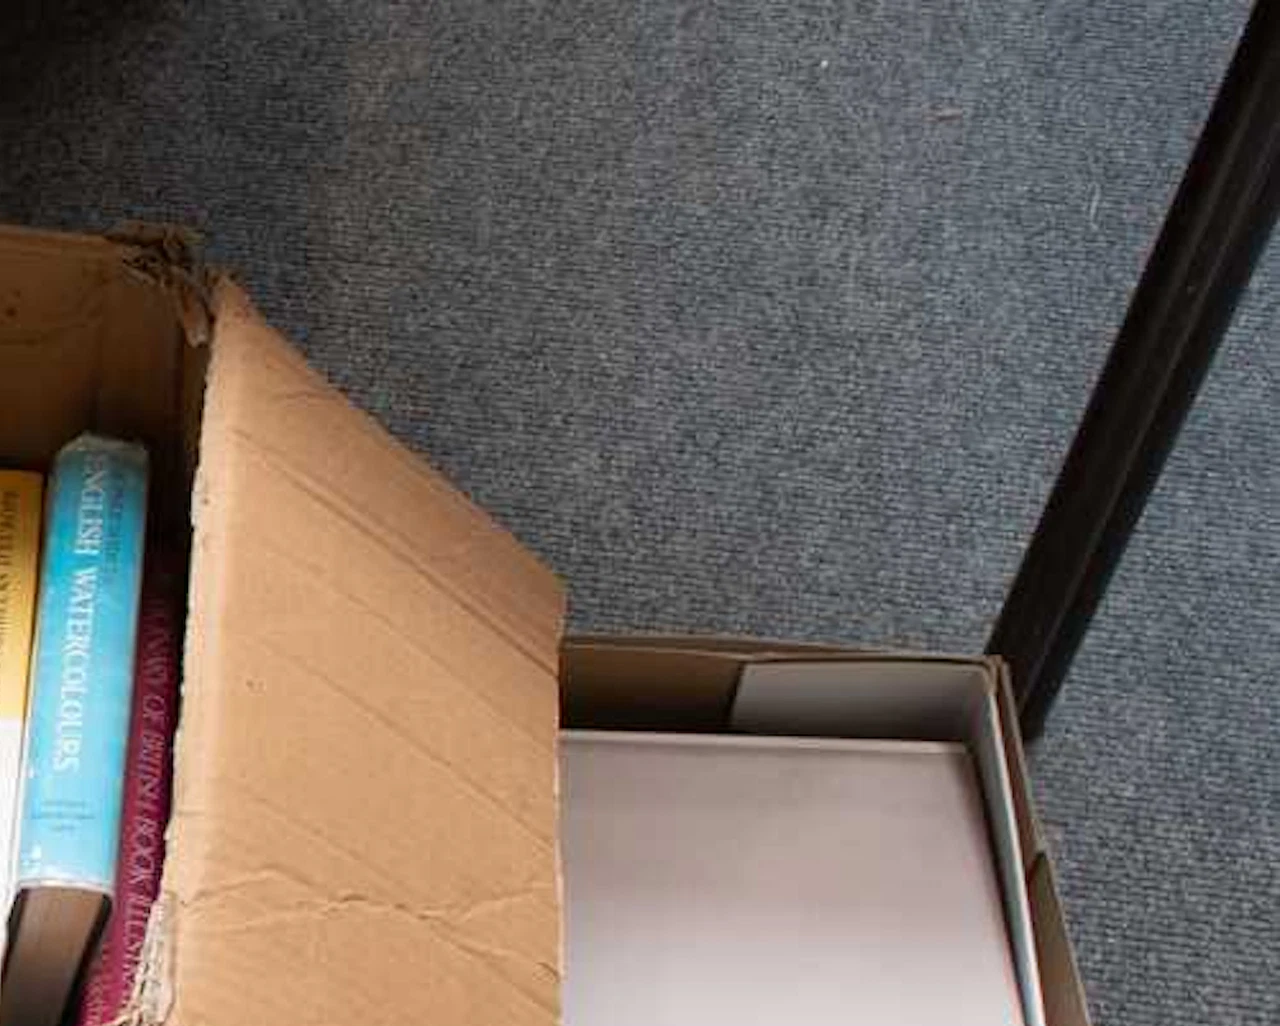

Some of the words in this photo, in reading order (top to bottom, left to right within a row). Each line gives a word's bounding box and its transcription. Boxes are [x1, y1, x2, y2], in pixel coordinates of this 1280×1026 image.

[75, 453, 108, 556] ENGLISH
[53, 565, 99, 773] WATERCOLOURS
[141, 692, 165, 725] OF
[135, 732, 164, 810] BRITISH
[129, 814, 158, 884] BOOK
